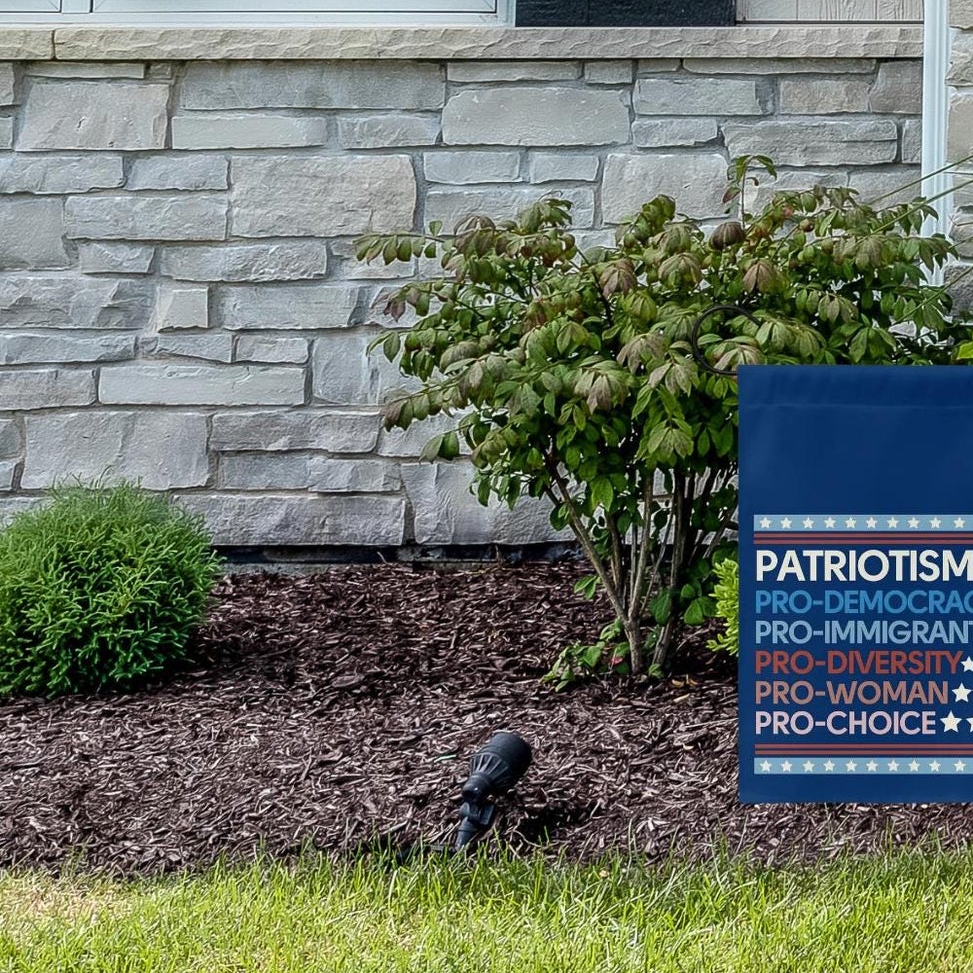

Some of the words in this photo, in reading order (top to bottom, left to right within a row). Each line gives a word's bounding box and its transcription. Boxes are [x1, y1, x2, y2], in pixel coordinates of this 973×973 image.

[756, 549, 973, 582] PATRIOTISM
[755, 650, 963, 674] PRO-DIVERSITY
[755, 681, 948, 704] PRO-WOMAN
[755, 711, 936, 735] PRO-CHOICE
